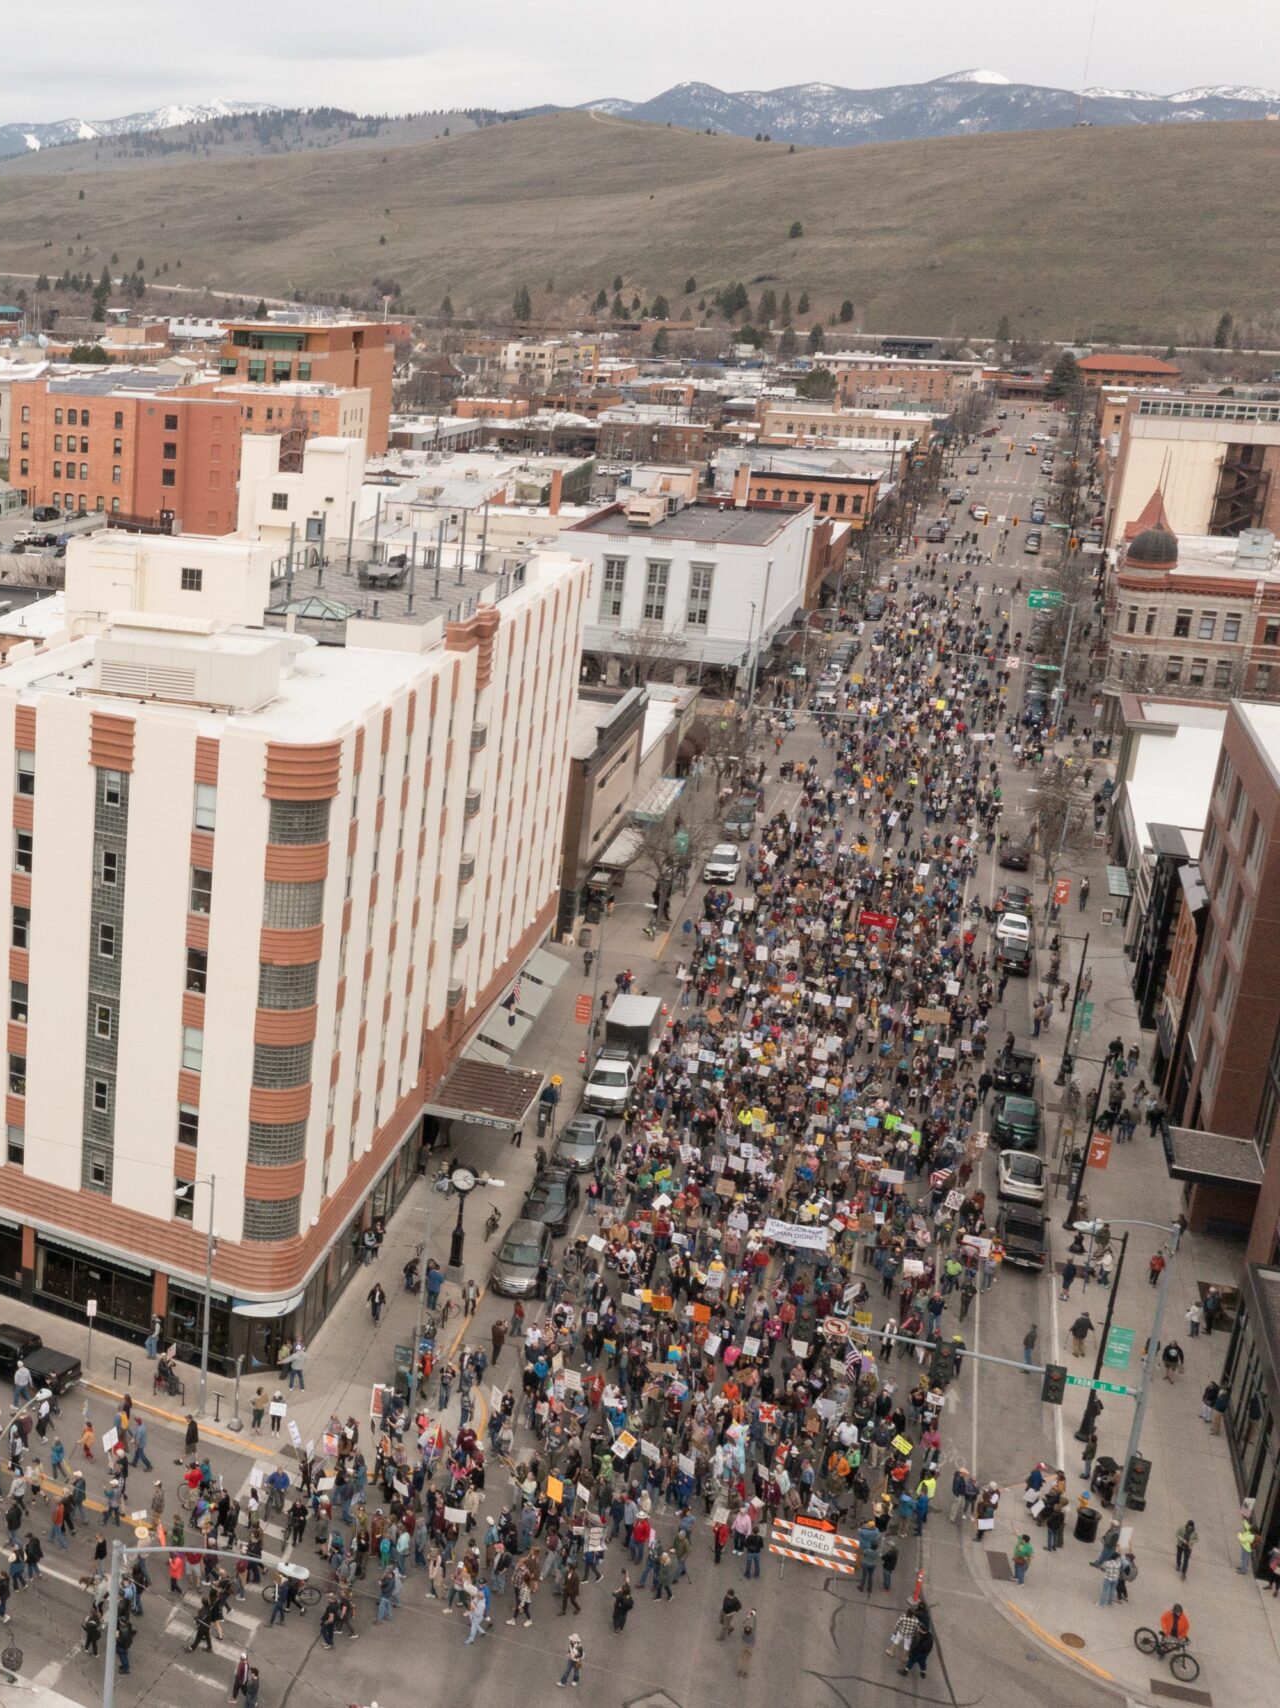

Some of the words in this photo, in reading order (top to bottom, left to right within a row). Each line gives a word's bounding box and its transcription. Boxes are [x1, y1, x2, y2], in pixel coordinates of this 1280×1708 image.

[1074, 1378, 1095, 1389] FRONT
[801, 1529, 826, 1541] ROAD
[795, 1536, 830, 1551] CLOSED
